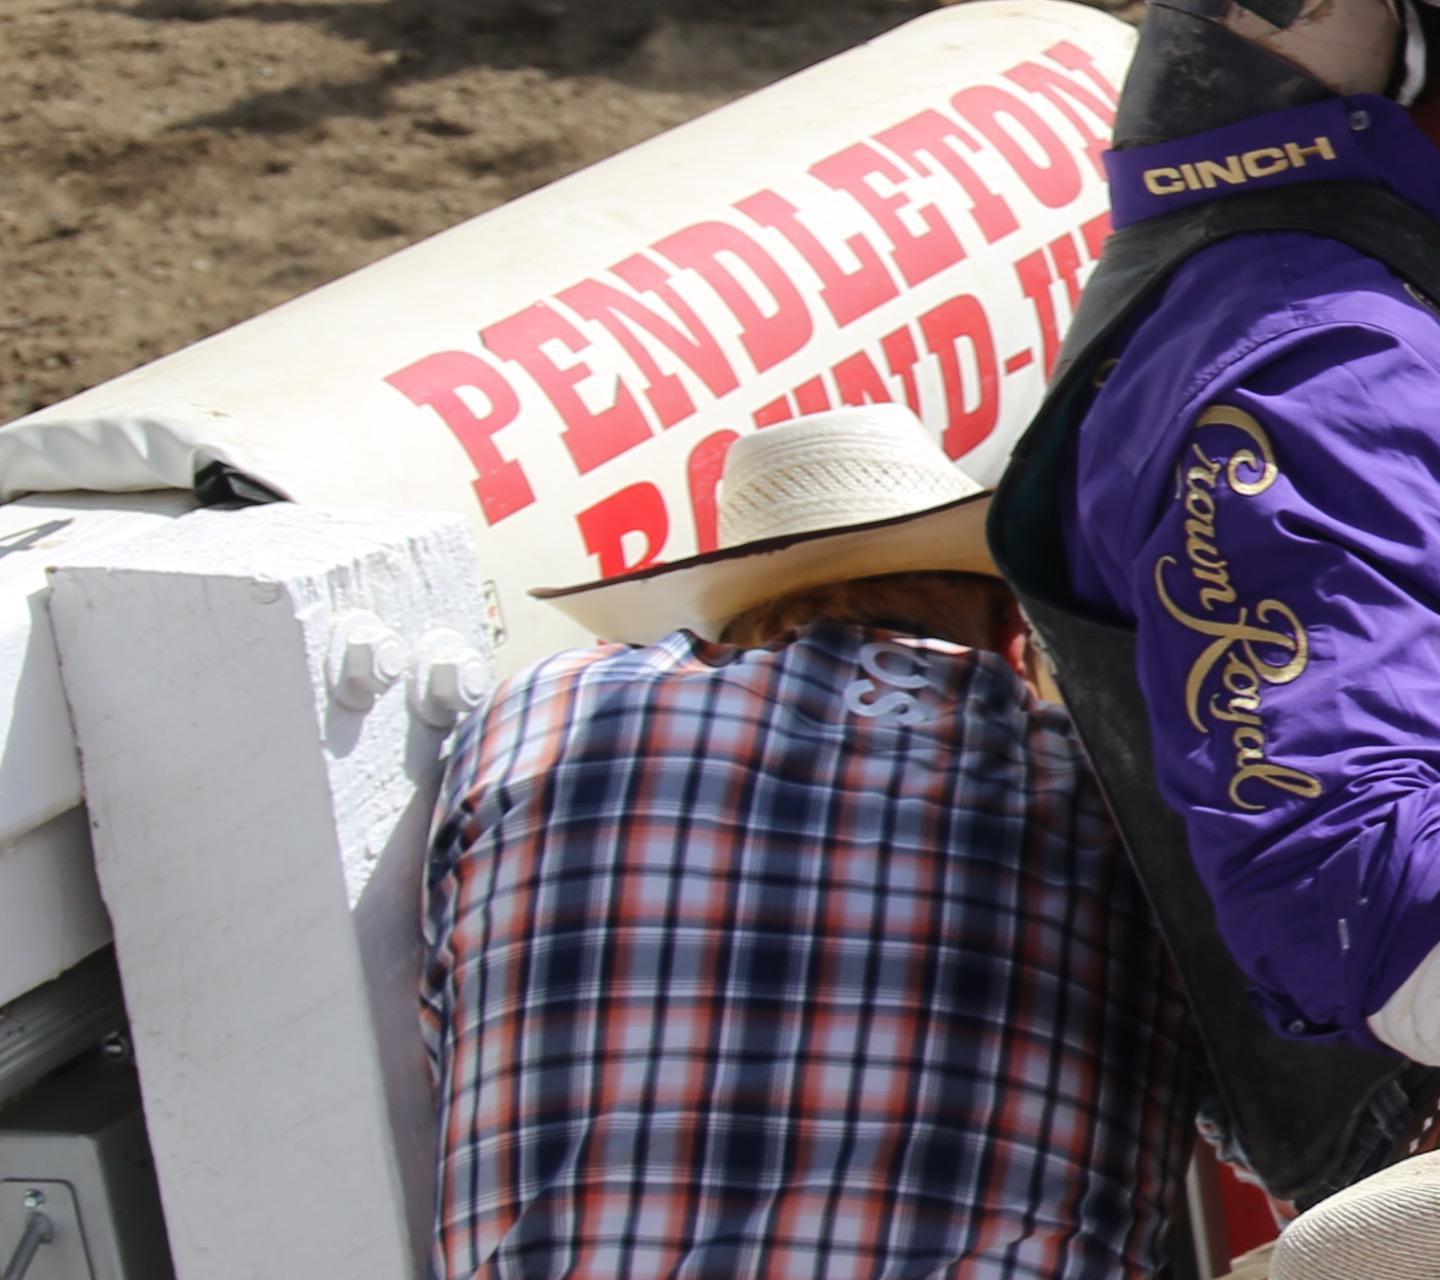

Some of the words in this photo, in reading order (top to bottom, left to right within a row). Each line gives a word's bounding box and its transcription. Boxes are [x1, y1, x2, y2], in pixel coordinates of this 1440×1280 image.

[384, 39, 1120, 525] PENDLETON
[1145, 137, 1336, 196] CINCH
[1174, 404, 1280, 611] Crown
[1154, 555, 1323, 810] Royal
